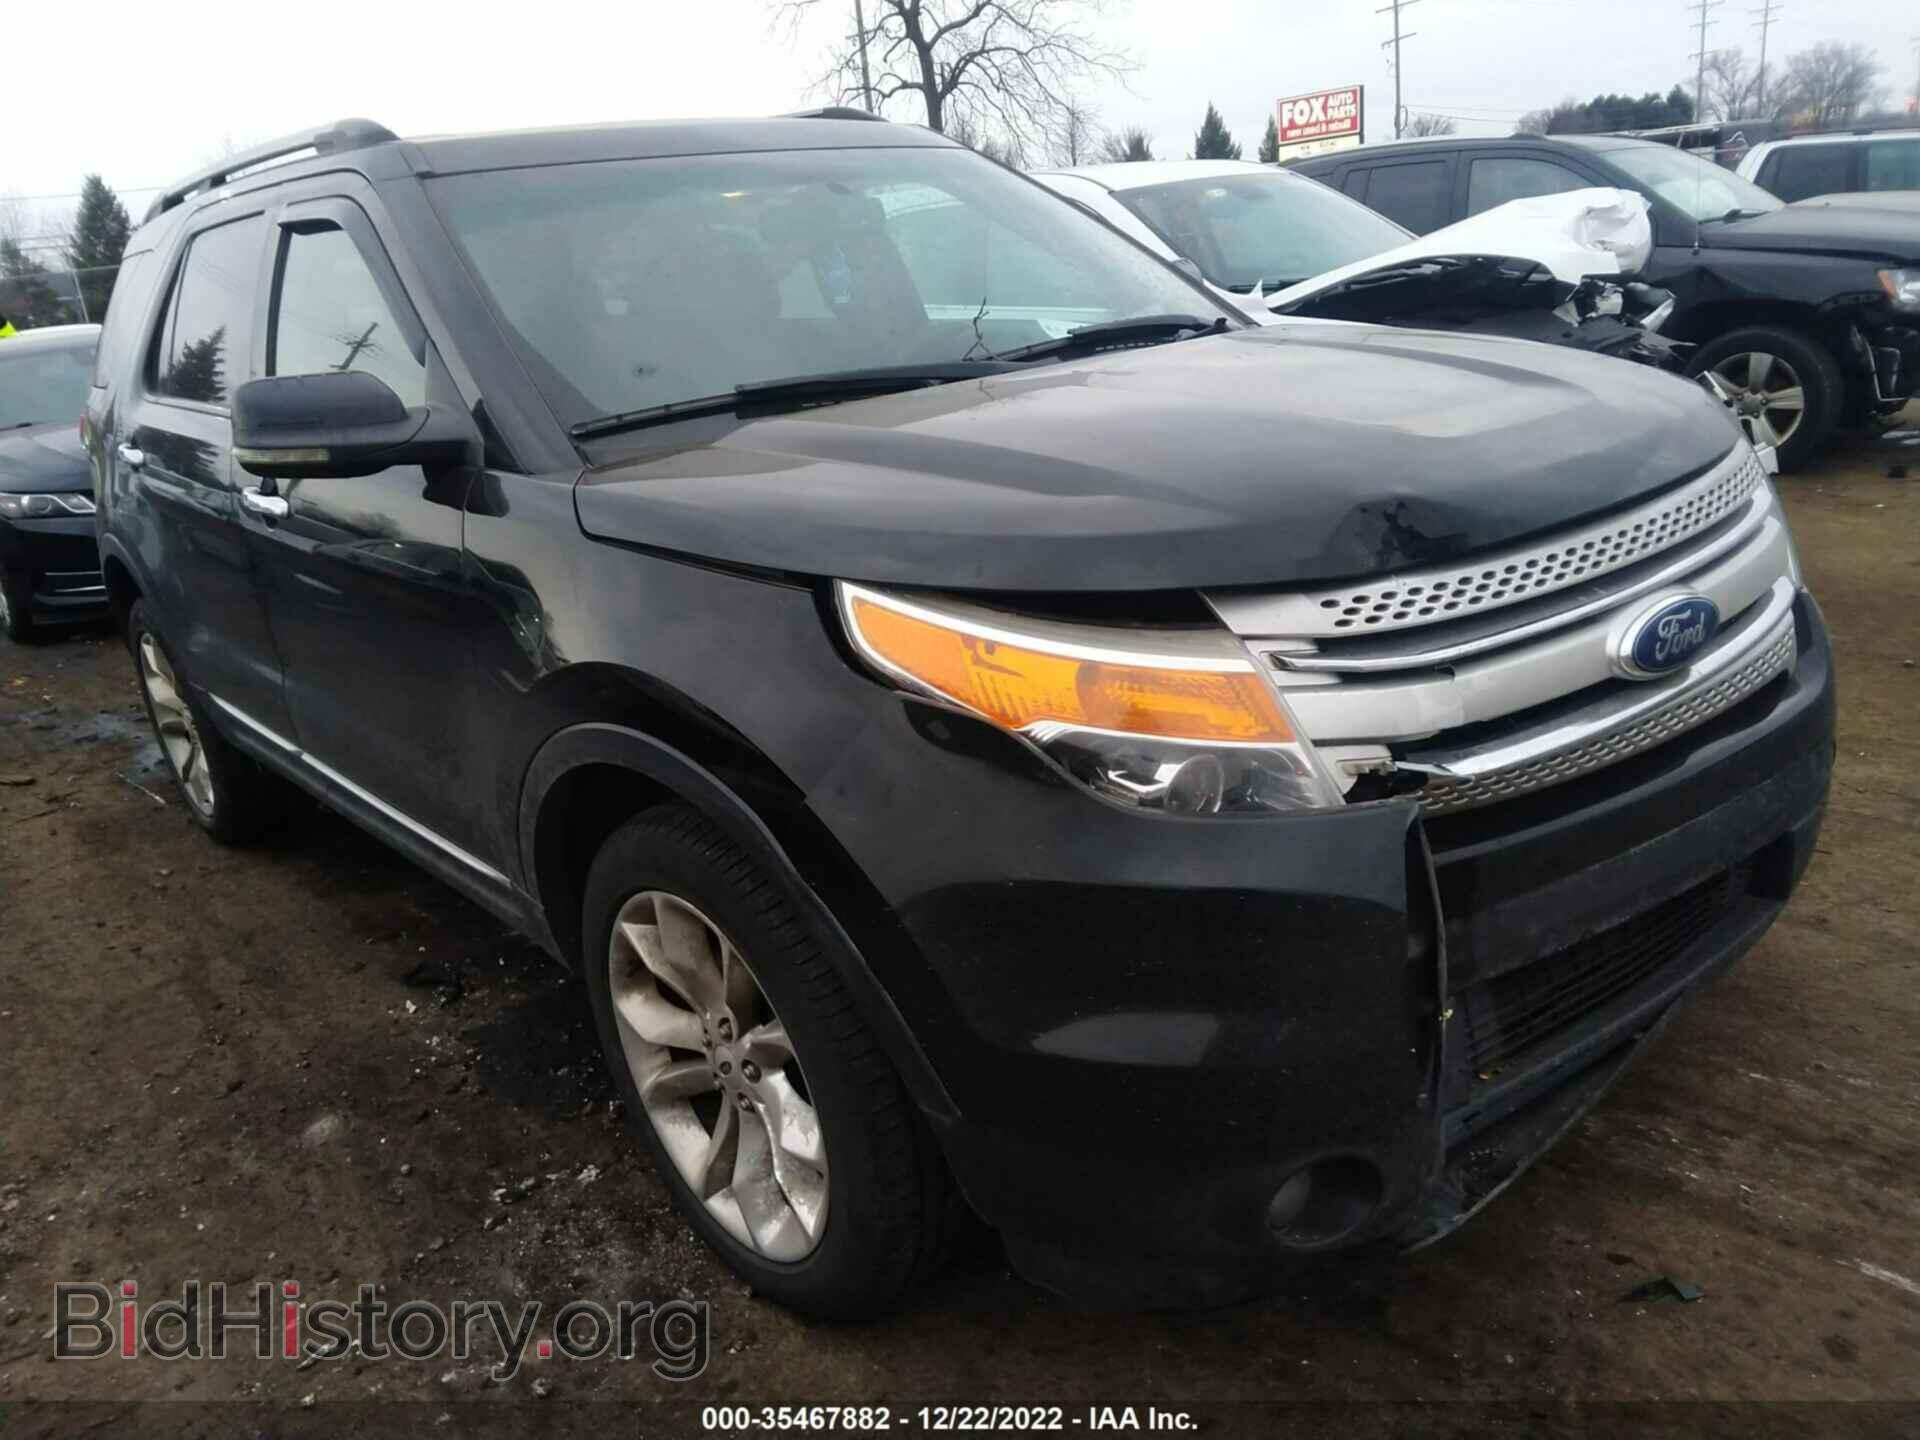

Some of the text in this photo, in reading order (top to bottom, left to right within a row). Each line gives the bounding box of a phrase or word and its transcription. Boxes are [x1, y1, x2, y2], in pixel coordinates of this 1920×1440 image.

[1328, 91, 1355, 107] AUTO
[1281, 96, 1327, 128] FOX
[1327, 103, 1357, 121] PARTS
[1656, 608, 1705, 661] Ford
